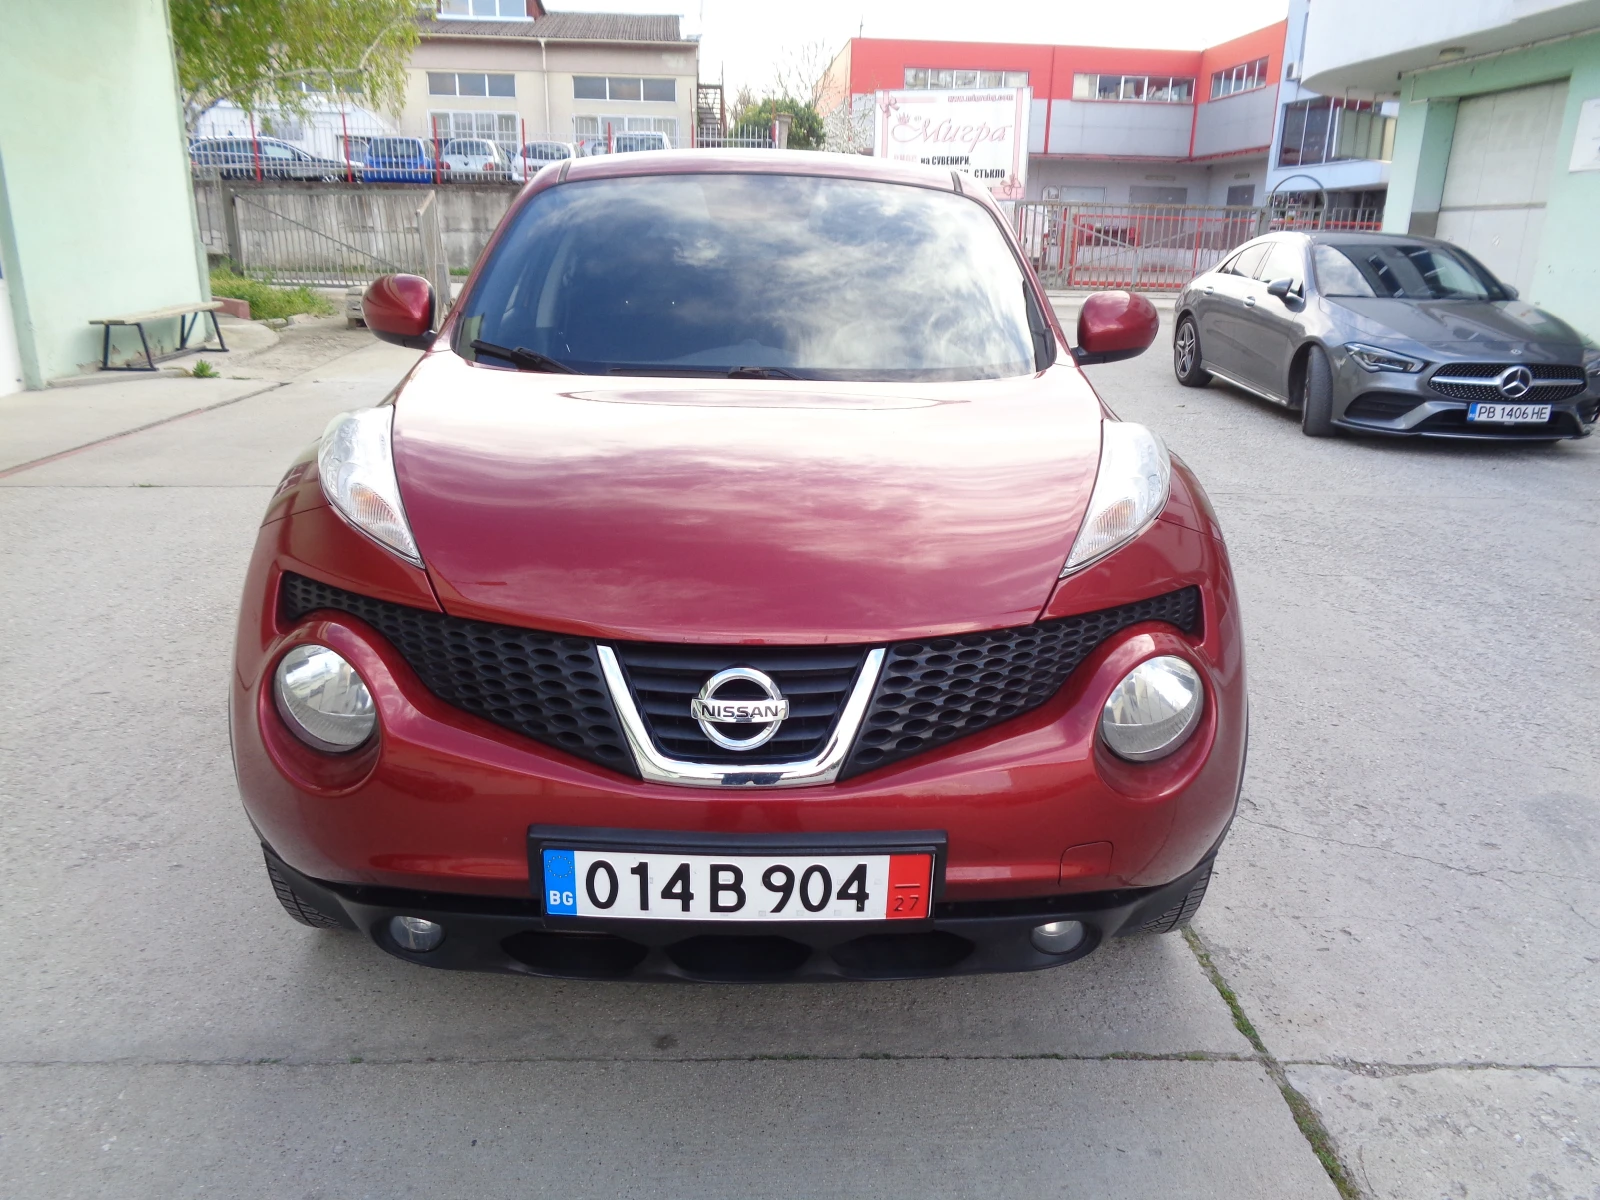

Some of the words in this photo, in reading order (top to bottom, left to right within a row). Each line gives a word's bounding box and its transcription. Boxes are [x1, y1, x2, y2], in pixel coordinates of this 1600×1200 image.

[891, 117, 1012, 153] Мигра
[974, 169, 1006, 179] СТЪКЛО
[1477, 406, 1496, 419] PB
[1500, 406, 1529, 419] 1406
[701, 704, 778, 718] NISSAN
[549, 890, 574, 907] BG
[893, 895, 919, 912] 27
